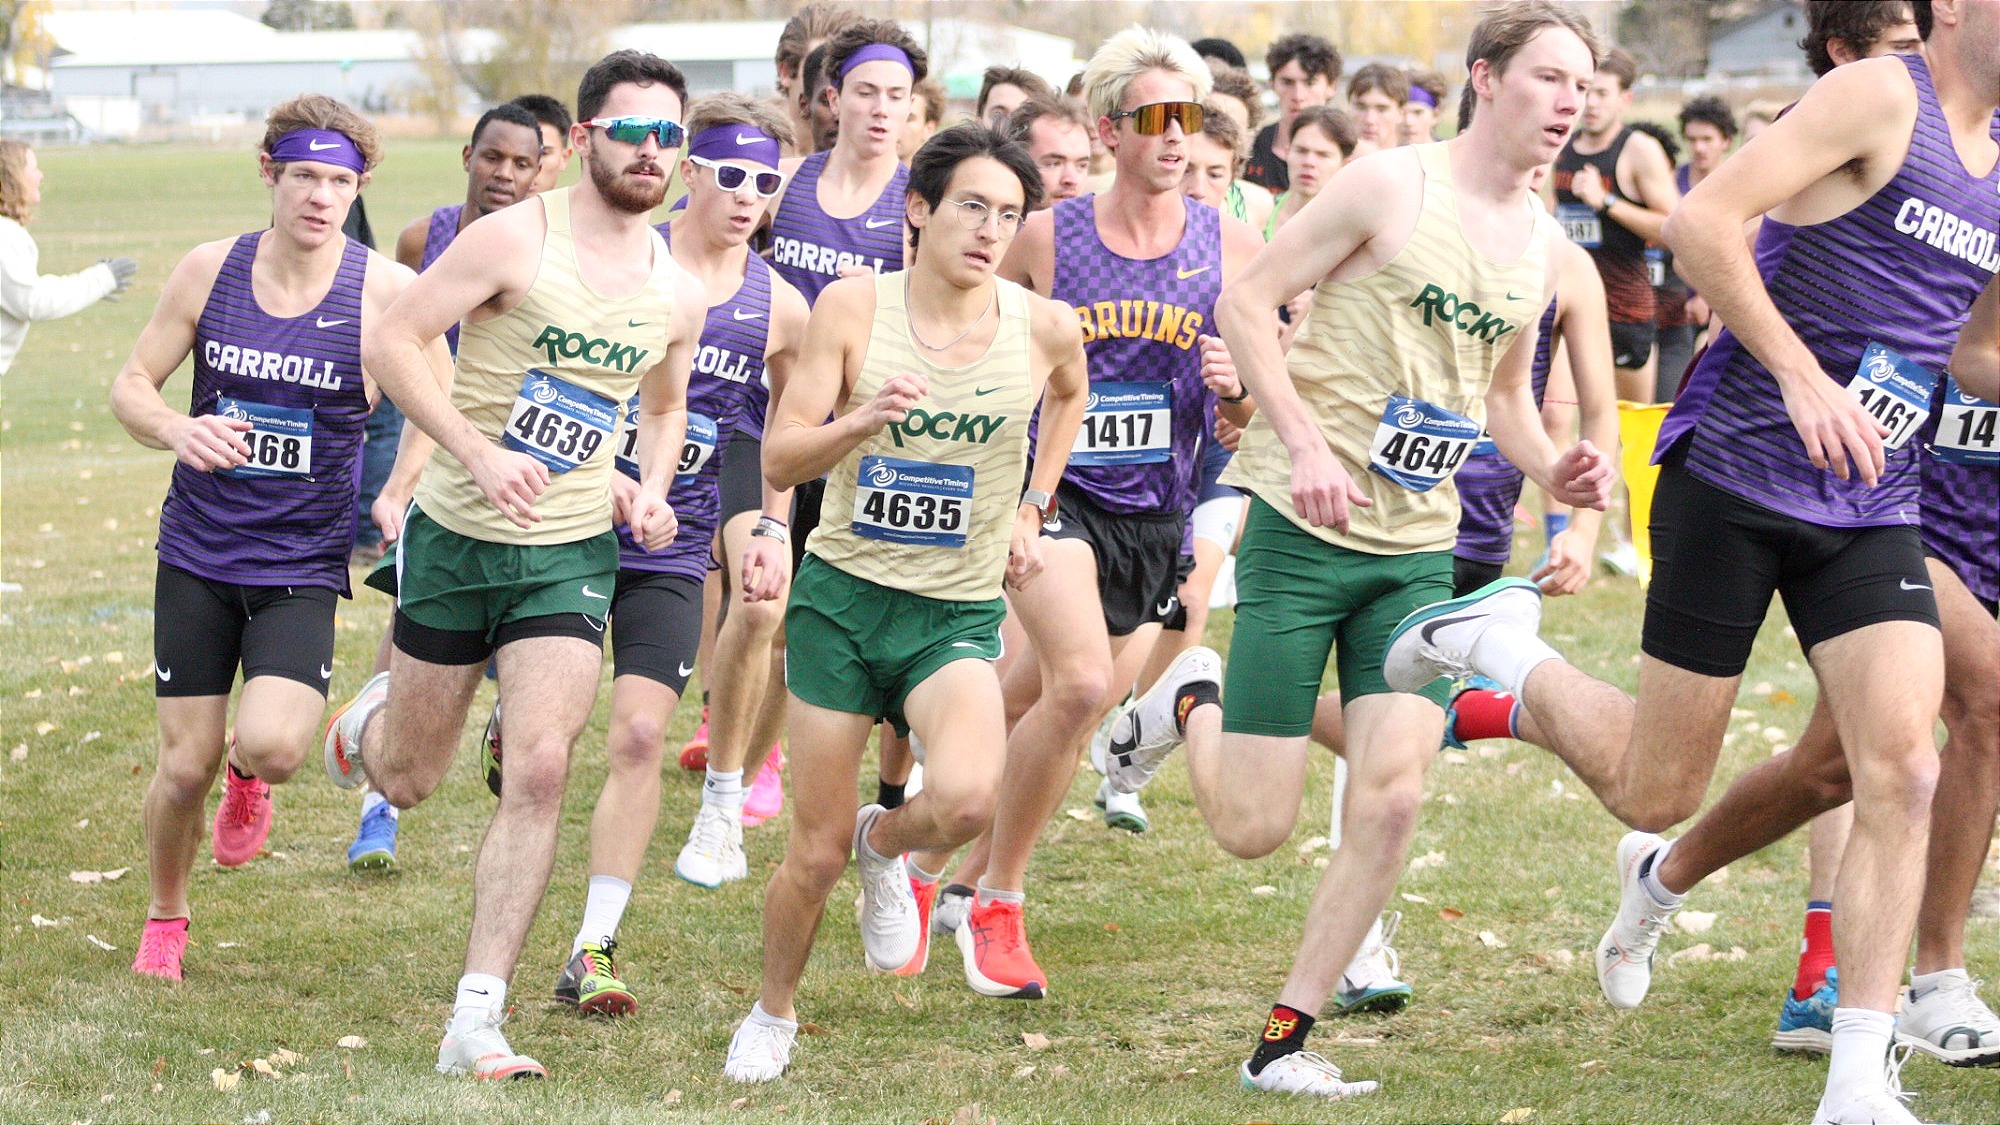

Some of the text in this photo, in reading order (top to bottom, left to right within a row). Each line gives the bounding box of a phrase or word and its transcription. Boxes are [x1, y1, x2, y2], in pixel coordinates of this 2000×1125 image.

[1894, 197, 1999, 274] CARROL
[1073, 300, 1203, 351] BRUINS
[1410, 283, 1515, 345] ROCKY
[205, 340, 342, 391] CARROLL
[532, 325, 649, 374] ROCKY
[514, 405, 603, 462] 4639
[1082, 413, 1153, 448] 1417
[1380, 431, 1468, 475] 4644
[863, 491, 962, 531] 4635
